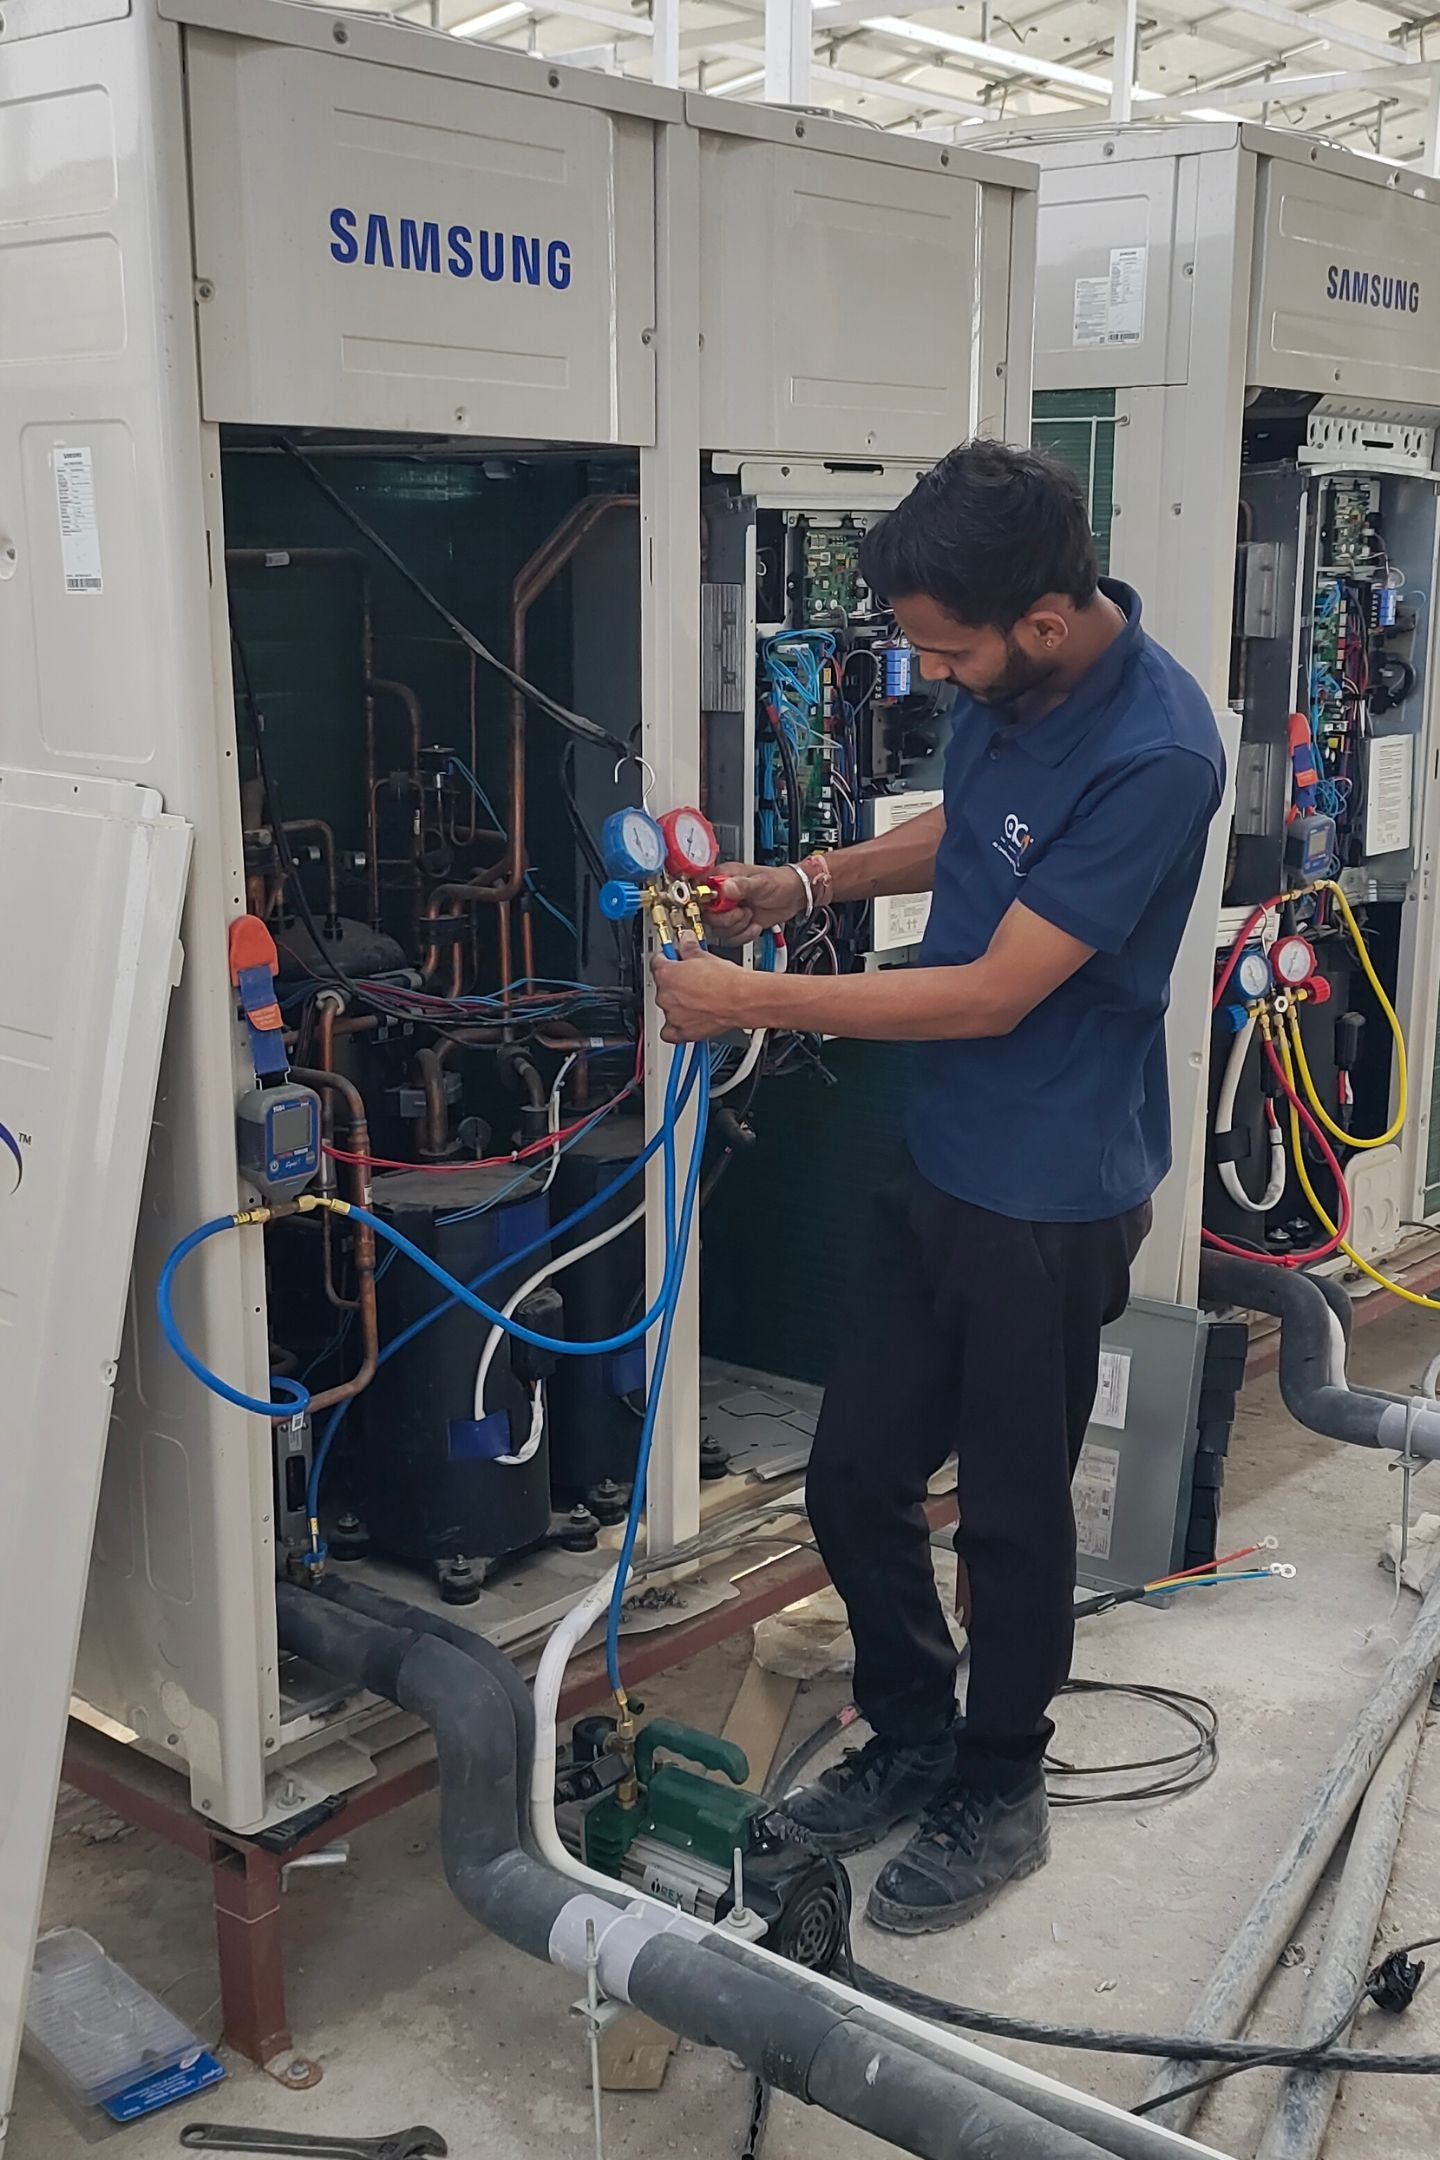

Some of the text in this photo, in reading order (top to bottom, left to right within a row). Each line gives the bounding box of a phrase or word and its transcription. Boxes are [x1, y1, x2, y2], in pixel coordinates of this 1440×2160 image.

[329, 207, 571, 290] SAMSUNG
[1326, 265, 1420, 314] SAMSUNG
[18, 1131, 32, 1146] TM
